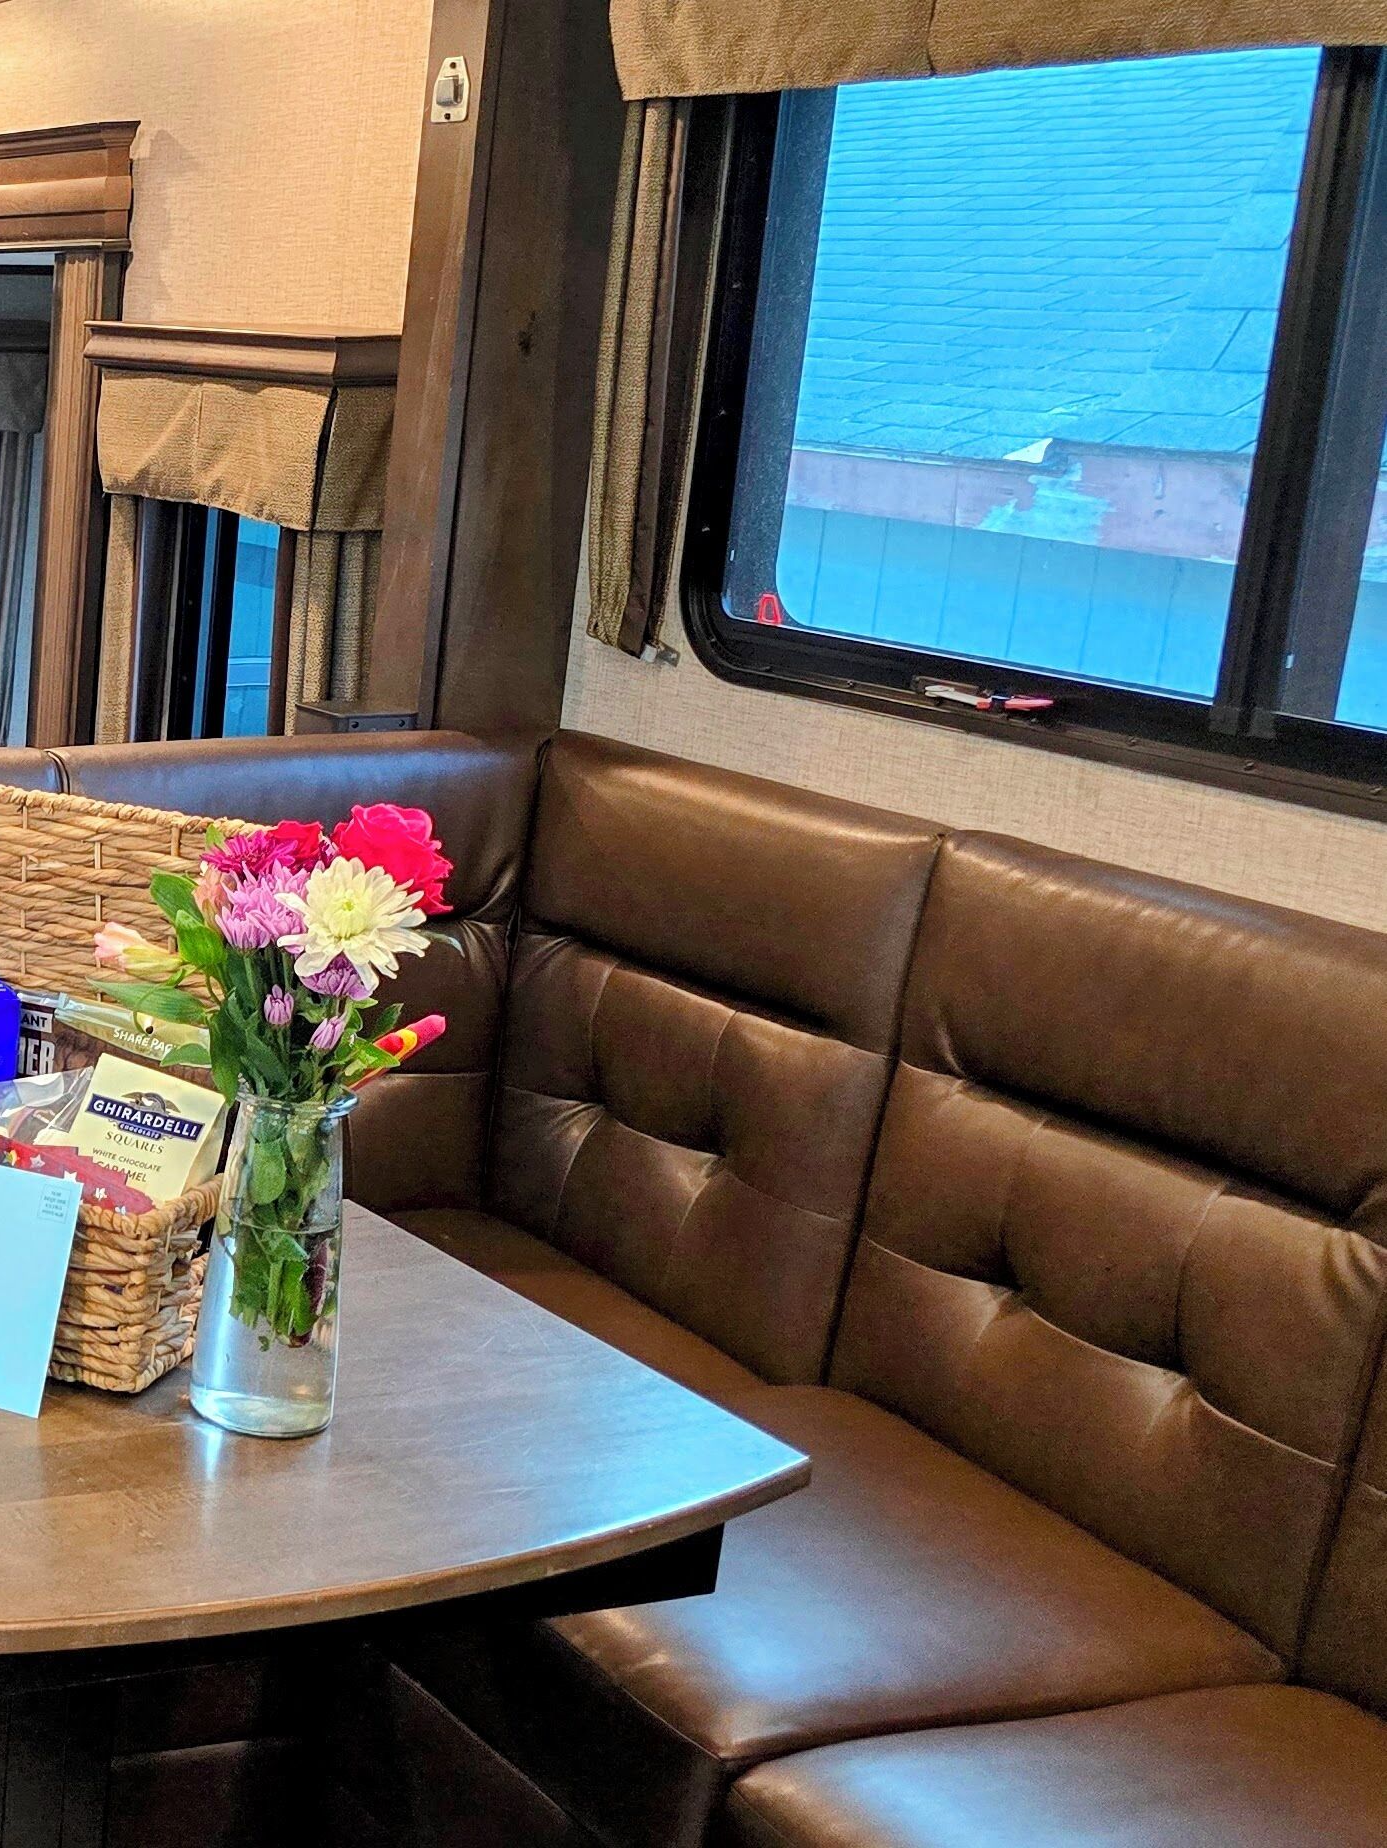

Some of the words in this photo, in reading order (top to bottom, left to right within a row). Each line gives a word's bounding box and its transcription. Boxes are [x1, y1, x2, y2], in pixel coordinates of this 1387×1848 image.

[20, 1016, 48, 1028] ANT
[113, 1029, 149, 1047] SHARE
[150, 1038, 176, 1053] PAC
[93, 1100, 198, 1137] GHIRARDELLI
[105, 1131, 164, 1154] SQUARES
[119, 1123, 161, 1139] CHOCOLATE
[93, 1148, 117, 1160] WHITE
[118, 1155, 162, 1172] CHOCOLATE
